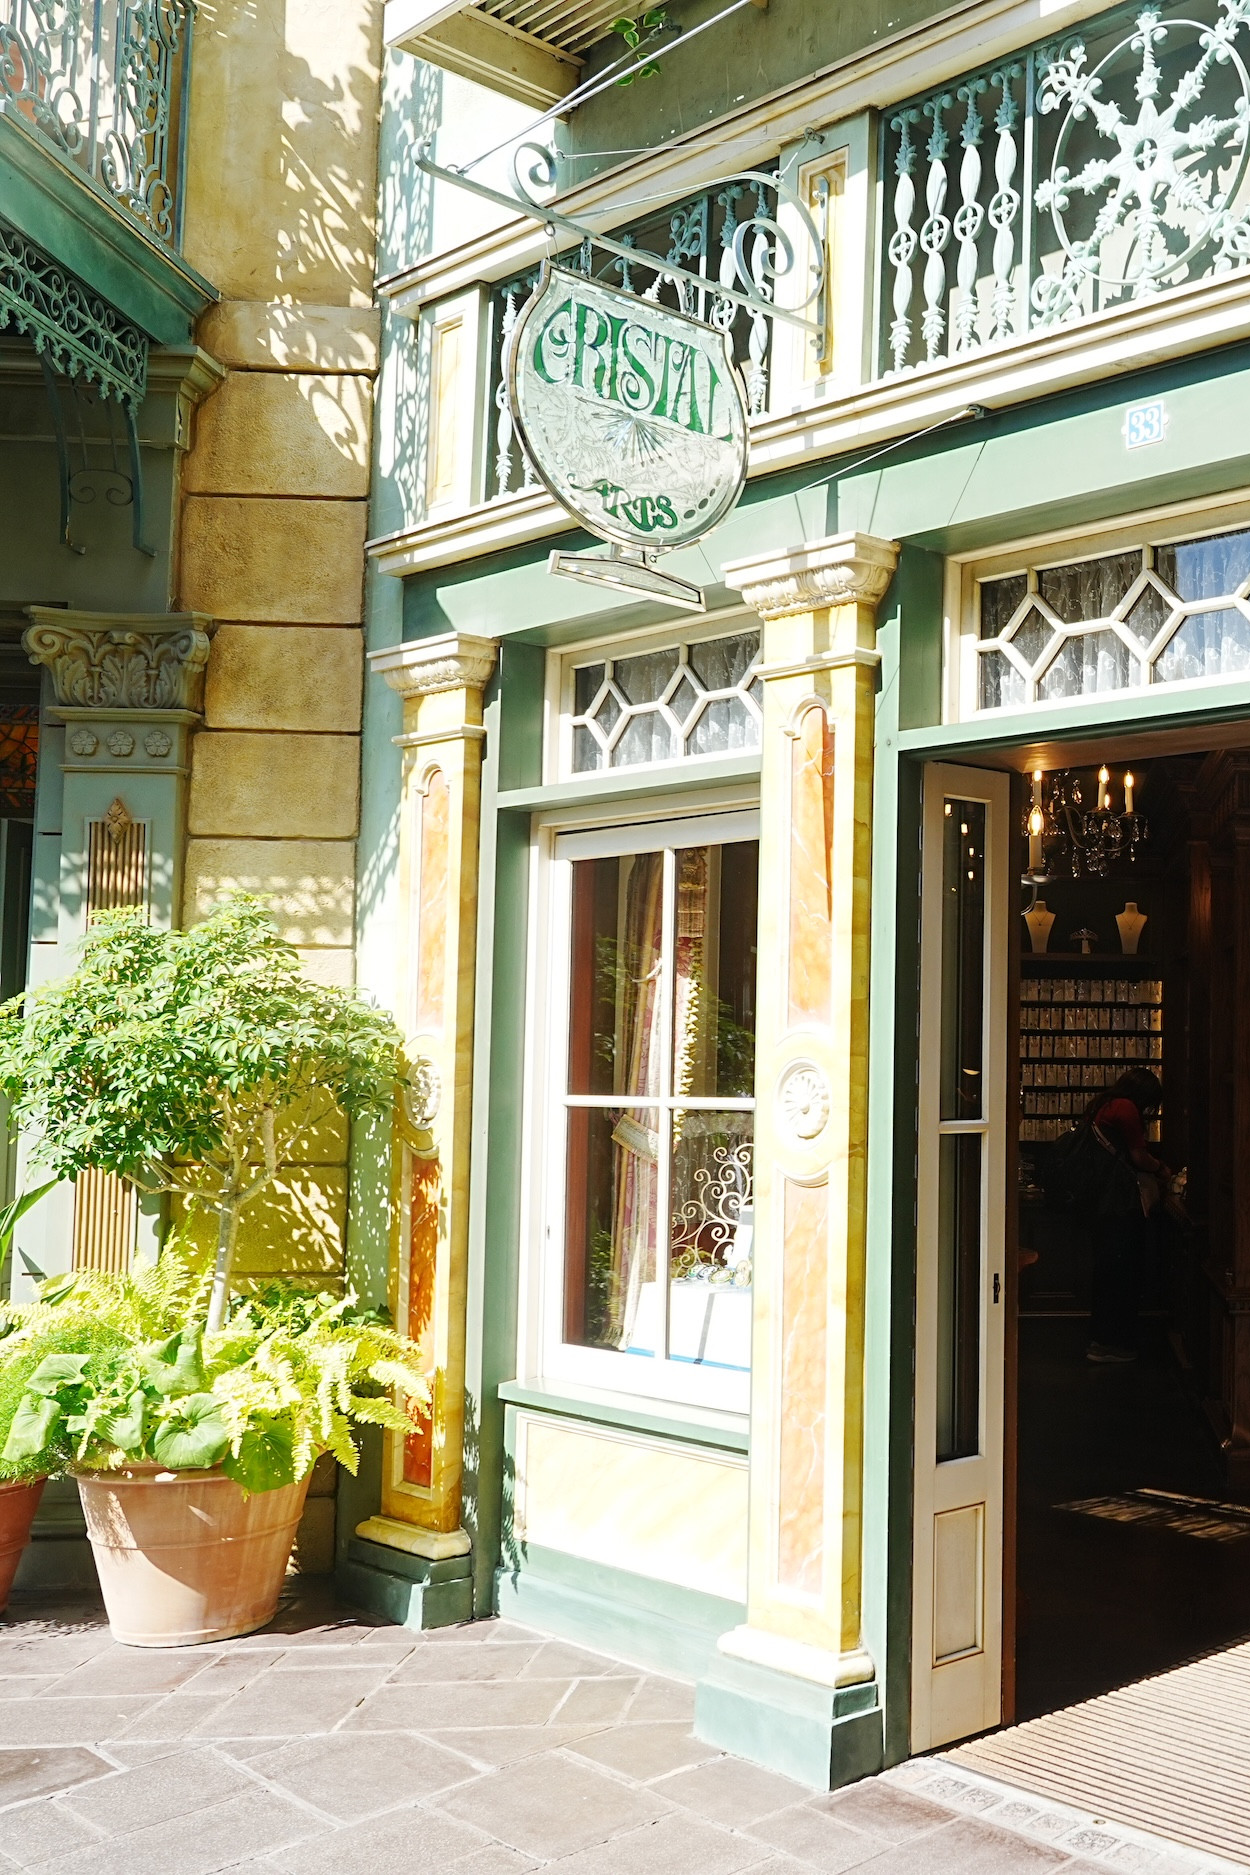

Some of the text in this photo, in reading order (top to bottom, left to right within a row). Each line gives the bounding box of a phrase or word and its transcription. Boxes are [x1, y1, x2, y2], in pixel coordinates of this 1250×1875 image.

[533, 299, 734, 442] CRISTAL
[1130, 407, 1160, 442] 33
[567, 474, 678, 532] ARTS
